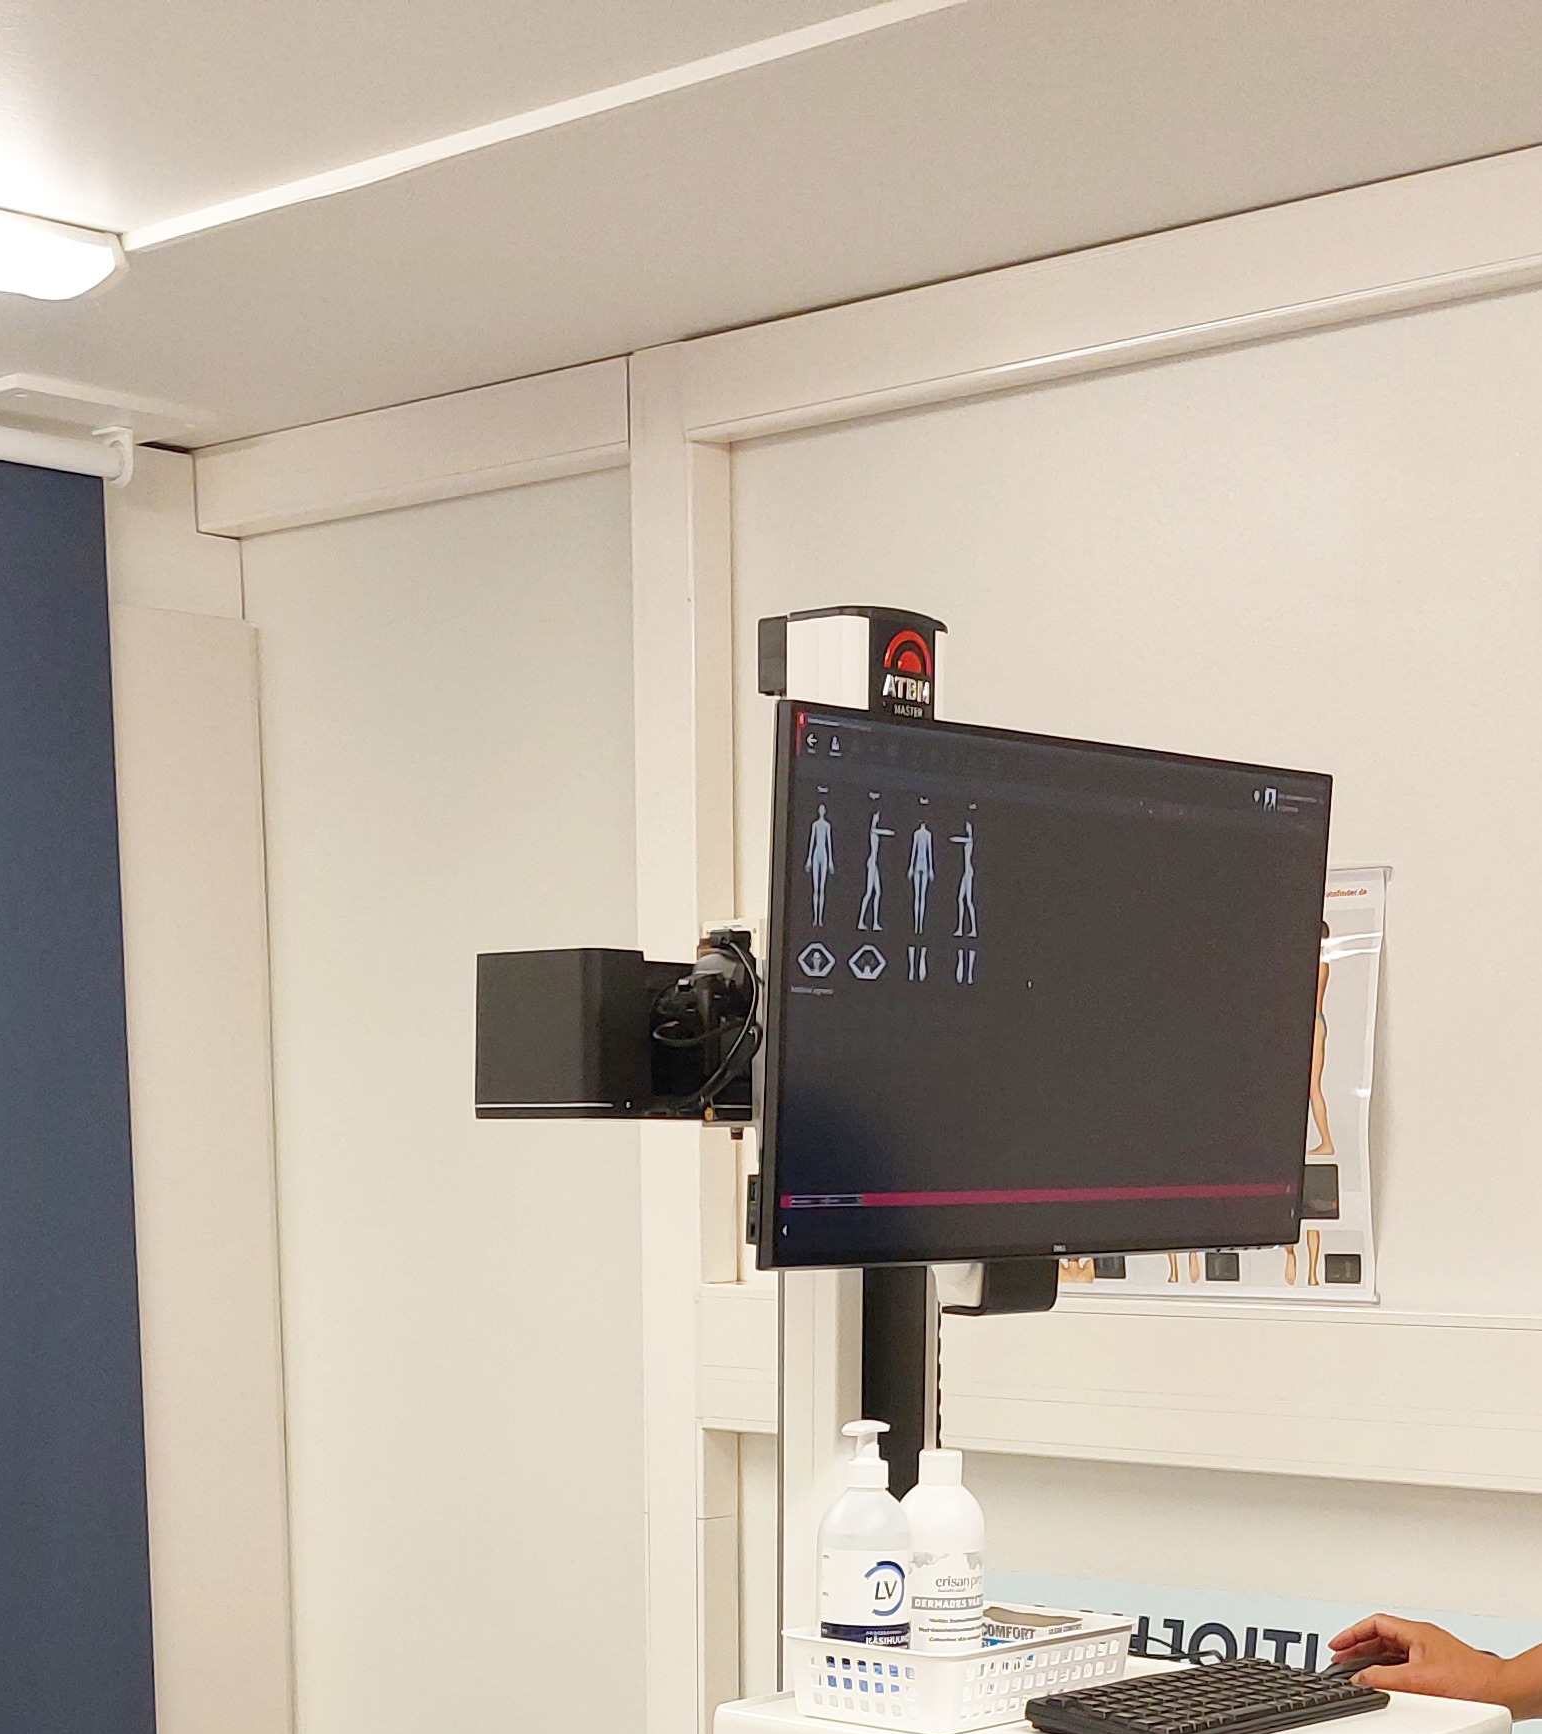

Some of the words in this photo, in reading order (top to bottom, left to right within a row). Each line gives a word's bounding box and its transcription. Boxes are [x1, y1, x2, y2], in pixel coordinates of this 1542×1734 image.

[882, 673, 930, 705] ATBM
[893, 703, 924, 719] MASTER
[874, 1580, 898, 1600] LV
